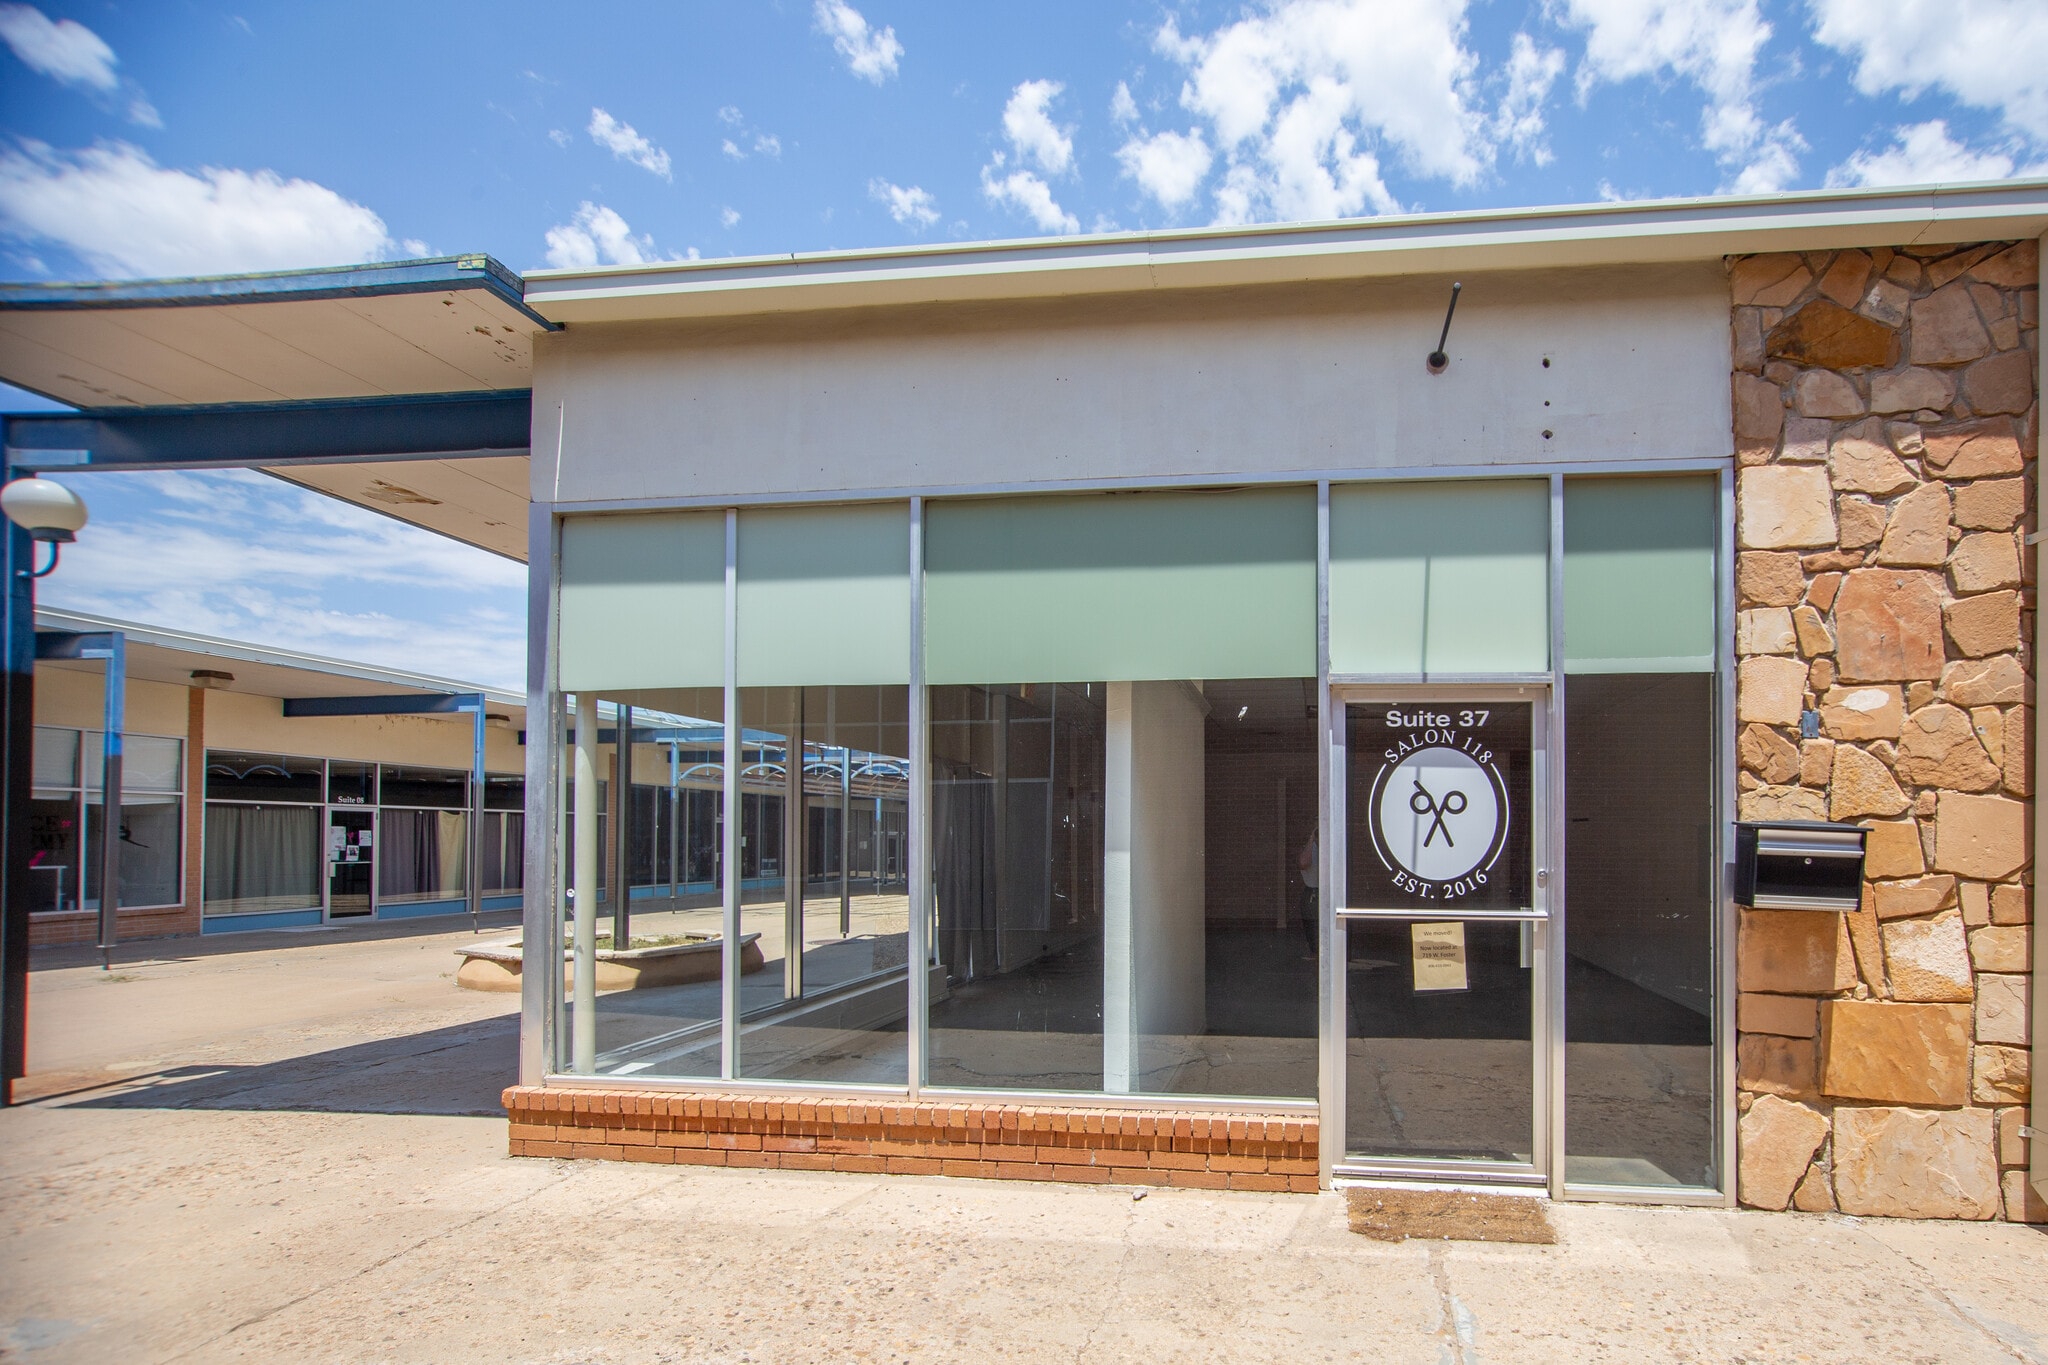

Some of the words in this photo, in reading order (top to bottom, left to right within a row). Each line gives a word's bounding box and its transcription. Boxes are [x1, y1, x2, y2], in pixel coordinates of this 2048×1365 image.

[1385, 710, 1451, 727] Suite
[1459, 710, 1490, 727] 37
[1384, 729, 1456, 763] SALON
[1462, 737, 1492, 763] 118
[337, 795, 356, 803] Suite
[1392, 870, 1435, 899] EST.
[1443, 869, 1487, 899] 2016
